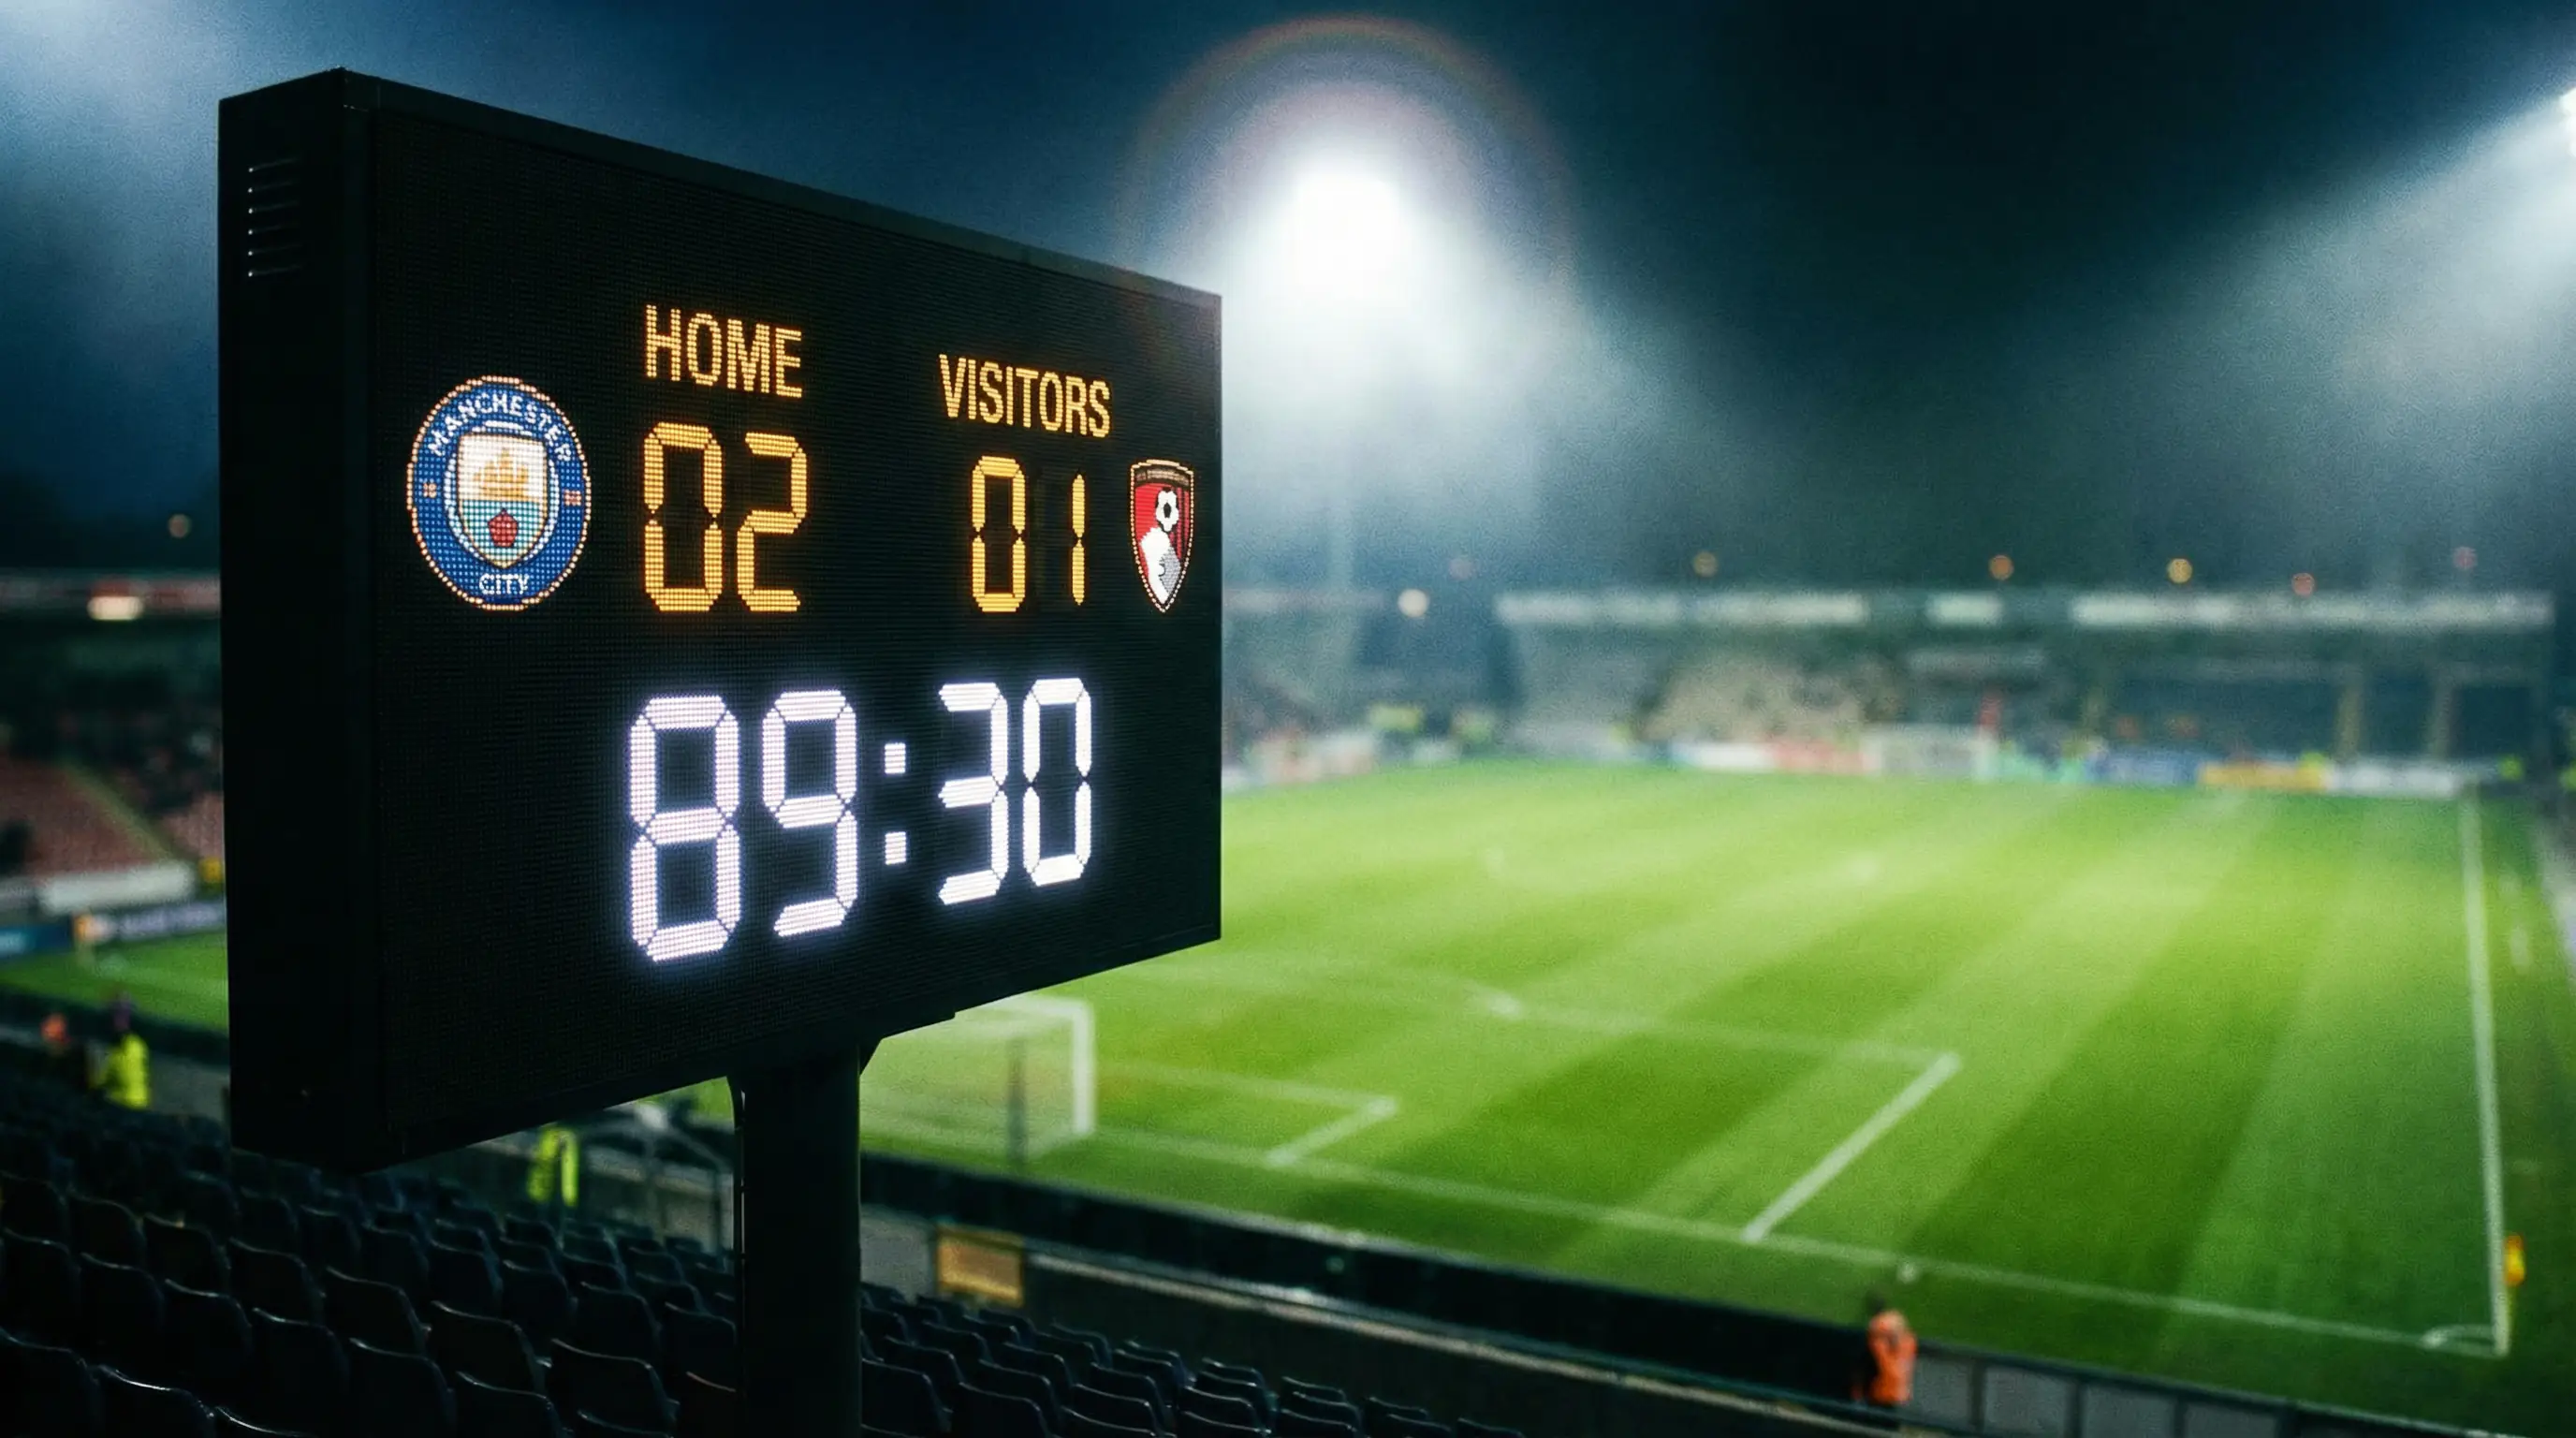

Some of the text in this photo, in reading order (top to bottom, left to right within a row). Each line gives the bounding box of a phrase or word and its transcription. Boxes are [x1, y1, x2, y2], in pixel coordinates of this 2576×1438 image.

[646, 304, 802, 398] HOME
[939, 353, 1111, 438] VISITORS
[428, 391, 573, 462] MANCHESTER
[643, 421, 808, 611] 02
[972, 456, 1086, 612] 01
[478, 573, 530, 595] CITY
[630, 678, 1091, 962] 89:30
